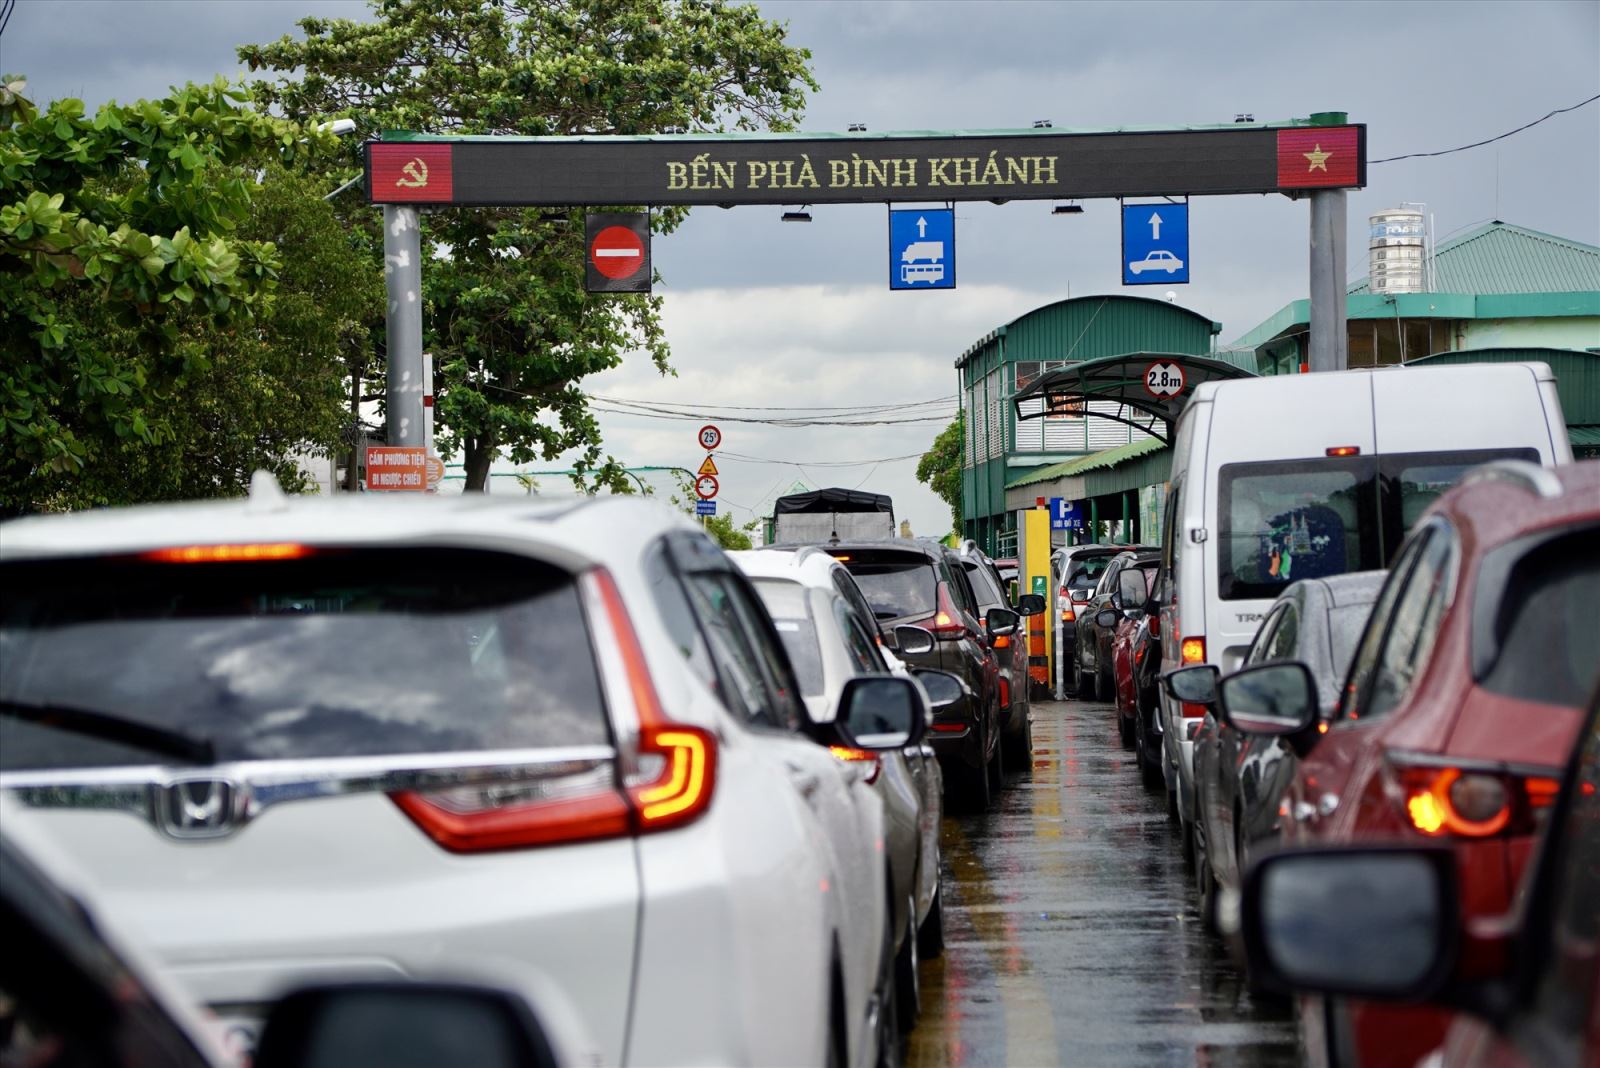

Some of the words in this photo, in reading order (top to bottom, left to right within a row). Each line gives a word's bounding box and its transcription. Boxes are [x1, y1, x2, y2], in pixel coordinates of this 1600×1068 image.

[666, 153, 737, 189] BẾN
[747, 153, 821, 189] PHÀ
[828, 153, 918, 188] BÌNH
[927, 150, 1059, 187] KHÁNH
[1148, 371, 1181, 387] 2.8m
[1059, 500, 1073, 518] P
